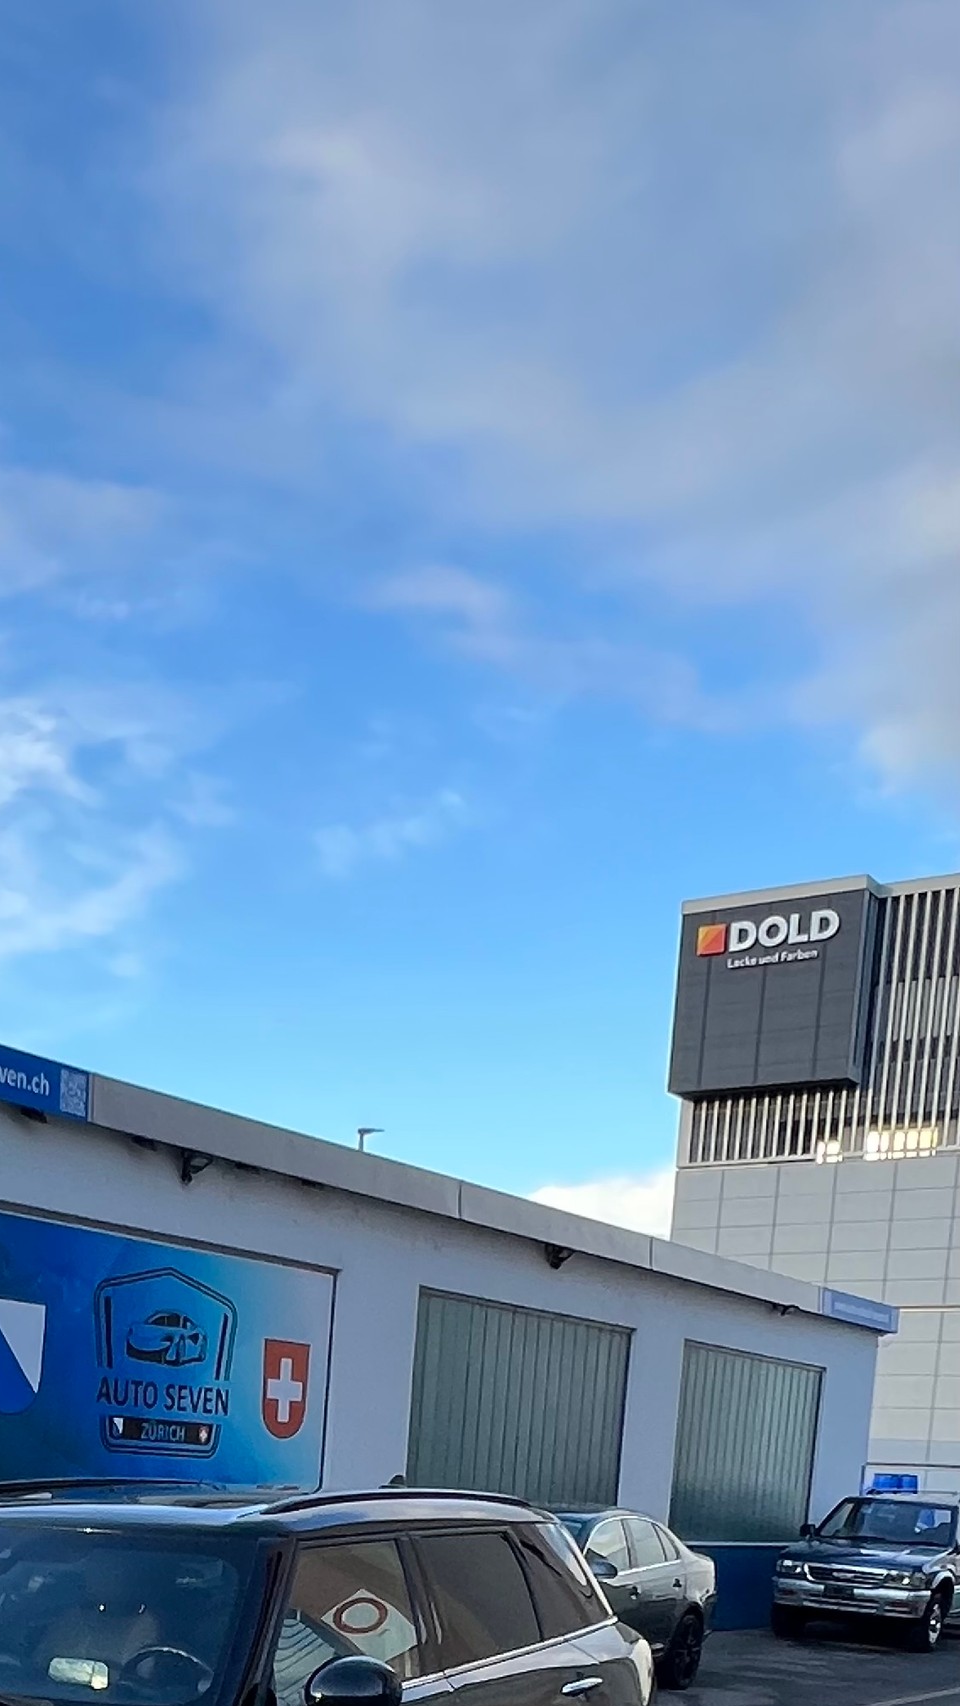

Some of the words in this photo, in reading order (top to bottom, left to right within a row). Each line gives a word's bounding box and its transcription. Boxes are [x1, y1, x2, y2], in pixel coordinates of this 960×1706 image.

[729, 909, 840, 952] DOLD
[727, 956, 756, 969] Lacke
[758, 952, 779, 964] und
[780, 949, 818, 962] Farben
[96, 1376, 158, 1409] AUTO
[164, 1384, 229, 1416] SEVEN
[141, 1421, 185, 1442] ZÜRICH
